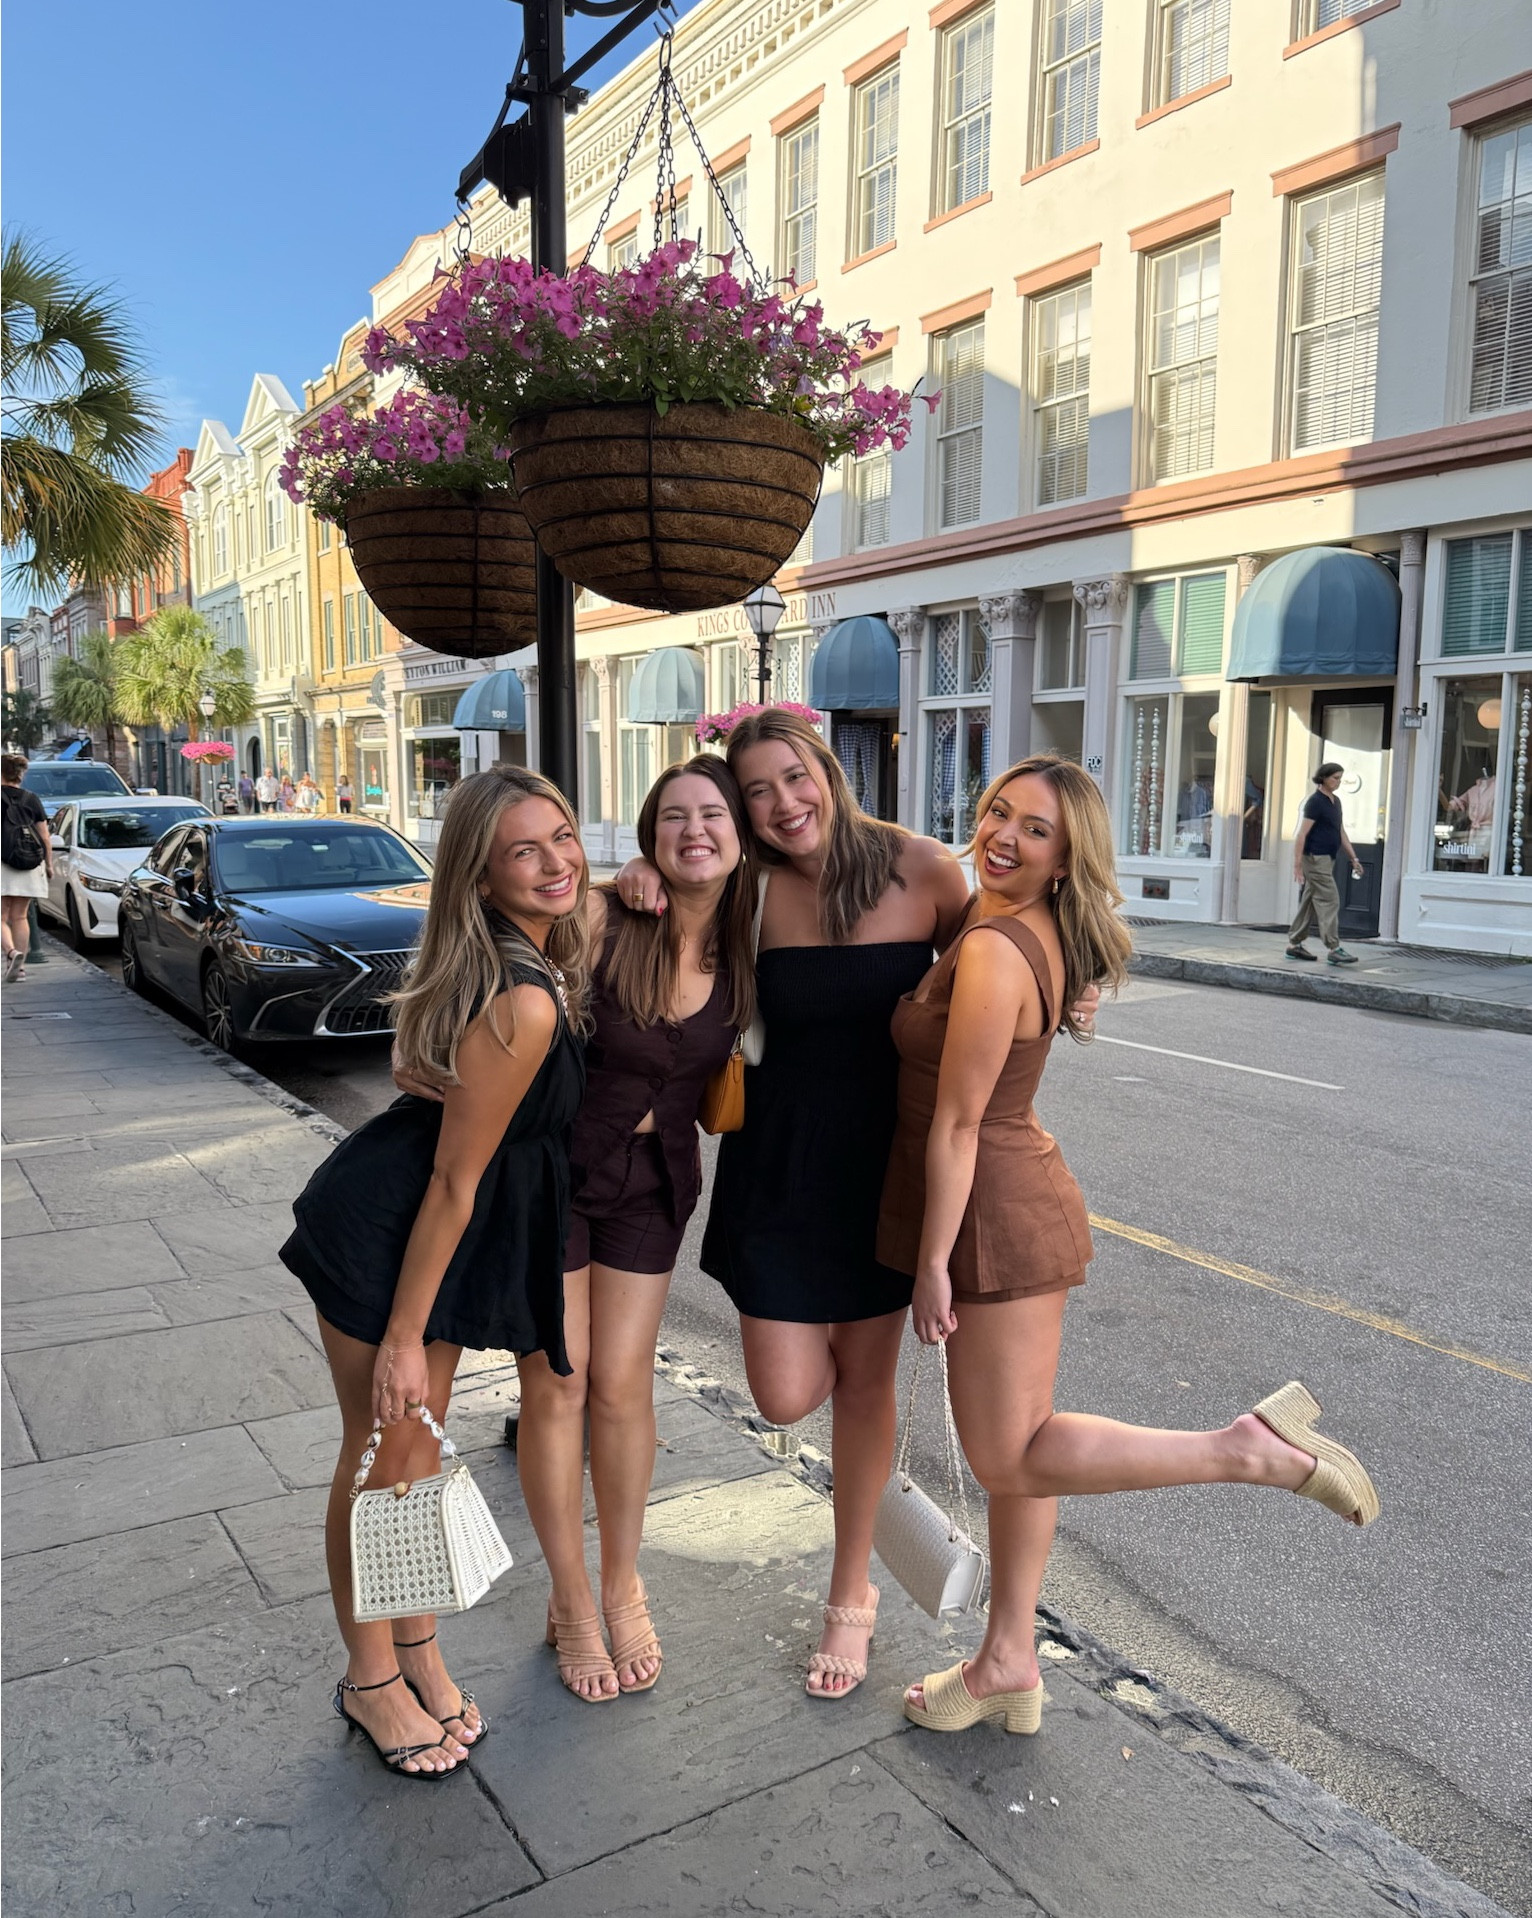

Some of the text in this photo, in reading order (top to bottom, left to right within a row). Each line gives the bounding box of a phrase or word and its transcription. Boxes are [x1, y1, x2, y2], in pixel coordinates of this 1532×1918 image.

[697, 592, 836, 637] KINGS COARD INN
[491, 709, 508, 719] 198
[1443, 840, 1476, 855] shirtini
